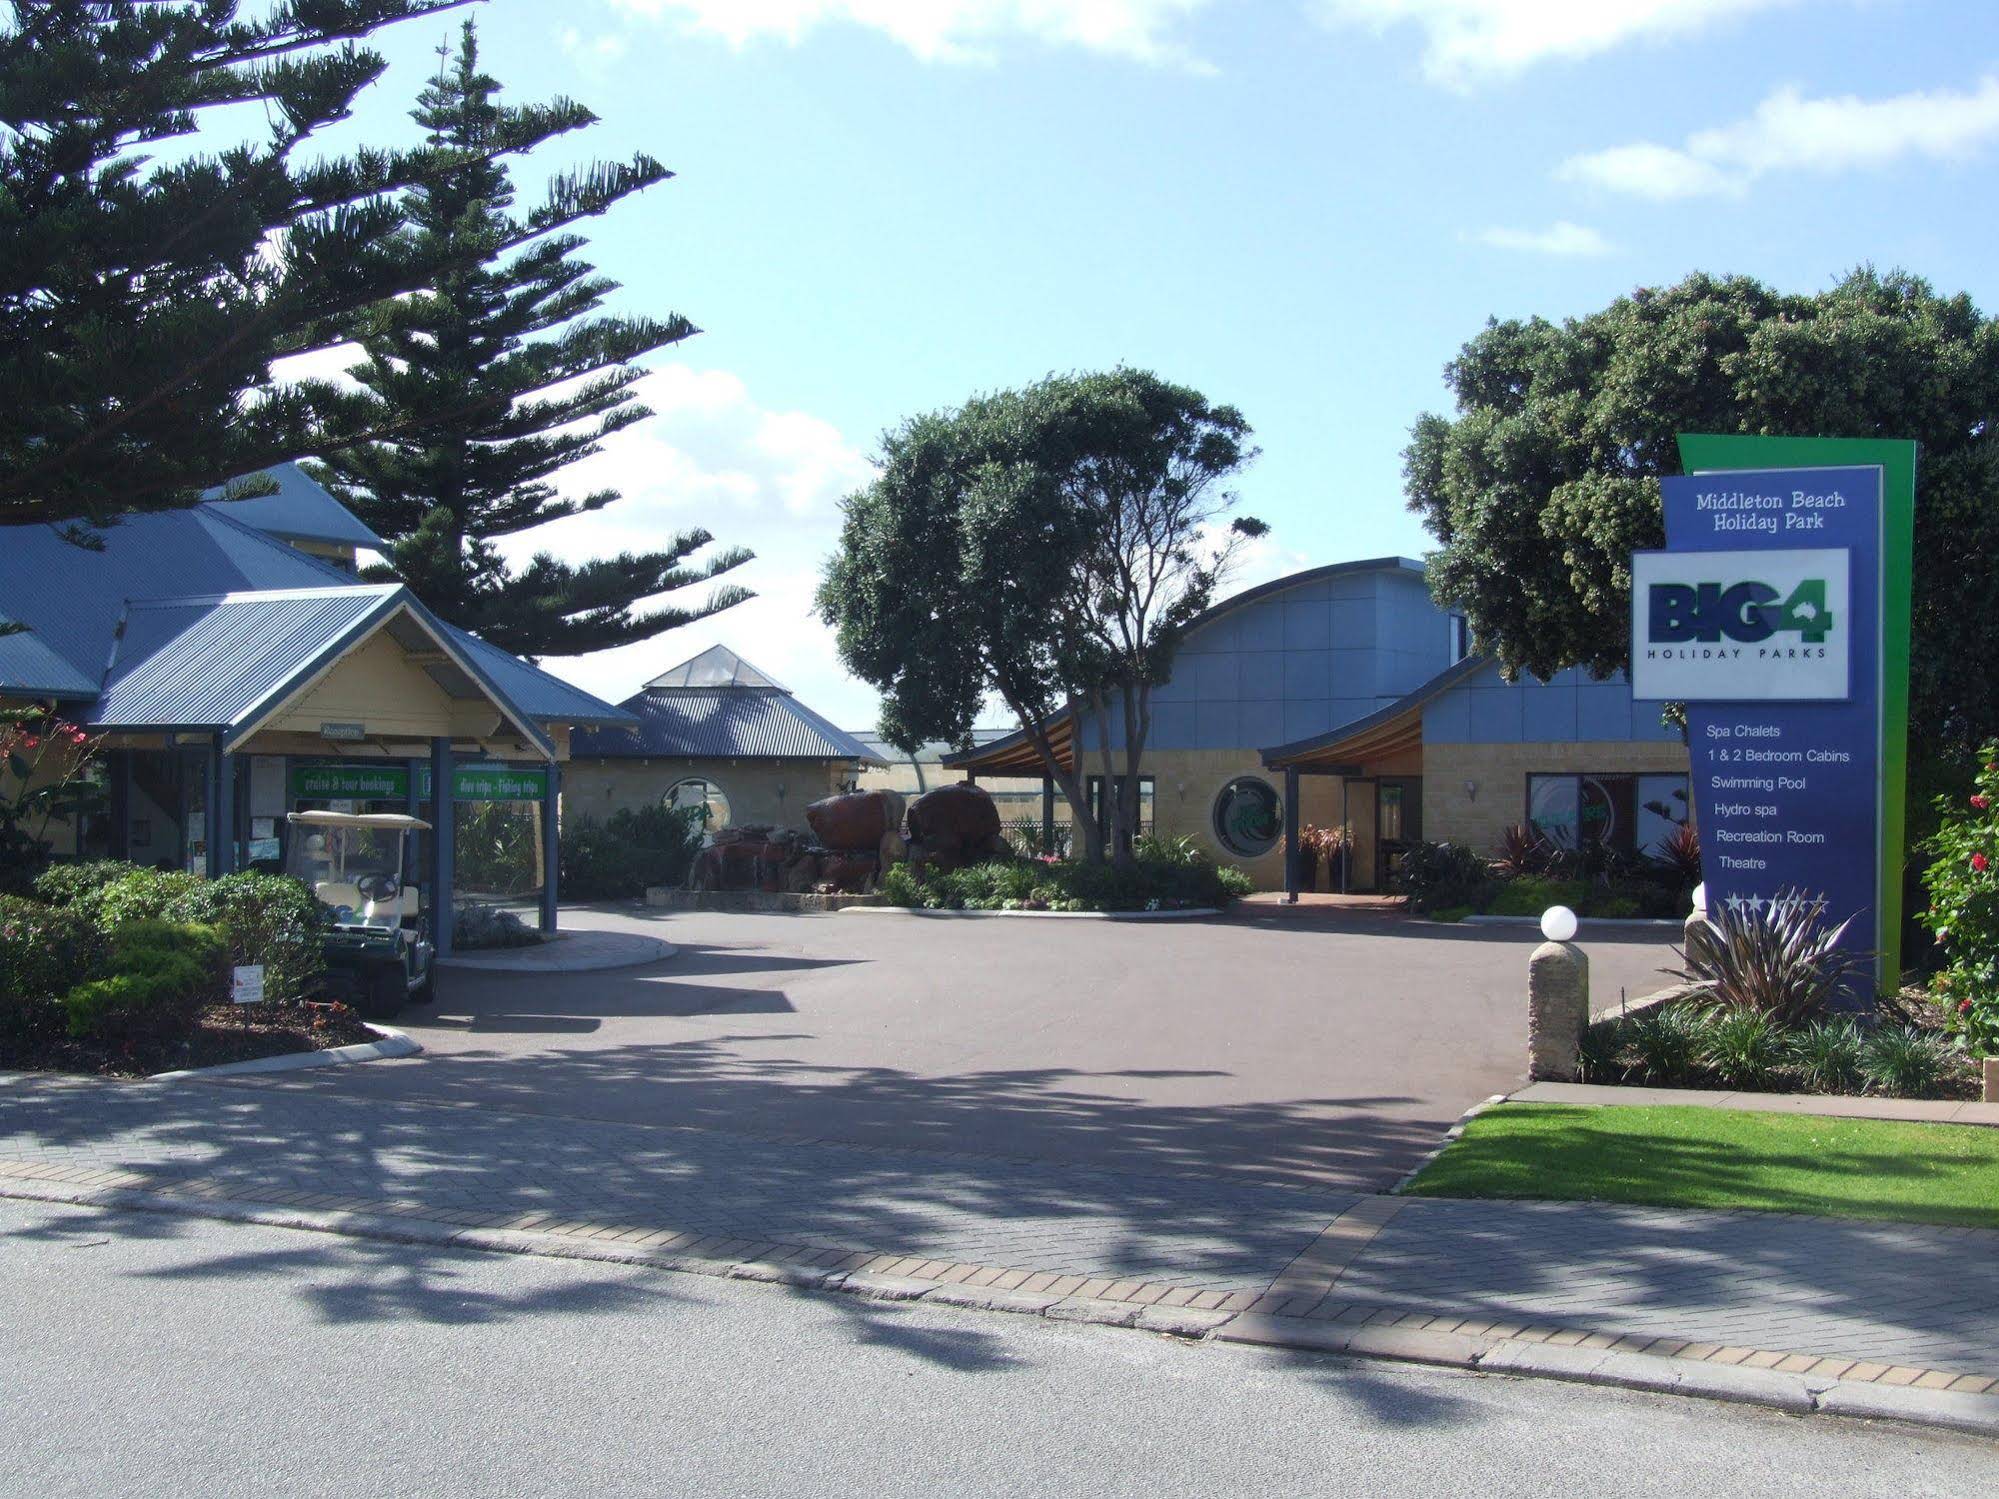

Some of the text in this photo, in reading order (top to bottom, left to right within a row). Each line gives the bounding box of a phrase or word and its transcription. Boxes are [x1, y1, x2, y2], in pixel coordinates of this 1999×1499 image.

[1696, 491, 1845, 511] Middleton Beach
[1713, 512, 1824, 533] Holiday Park
[1647, 648, 1826, 660] HOLIDAY PARKS
[1706, 725, 1781, 738] Spa Chalets
[1708, 750, 1850, 763] 1 & 2 Bedroom Cabins
[1711, 776, 1806, 792] Swimming Pool
[1714, 803, 1777, 818] Hydro spa
[1716, 830, 1825, 844] Recreation Room
[1719, 856, 1766, 870] Theatre
